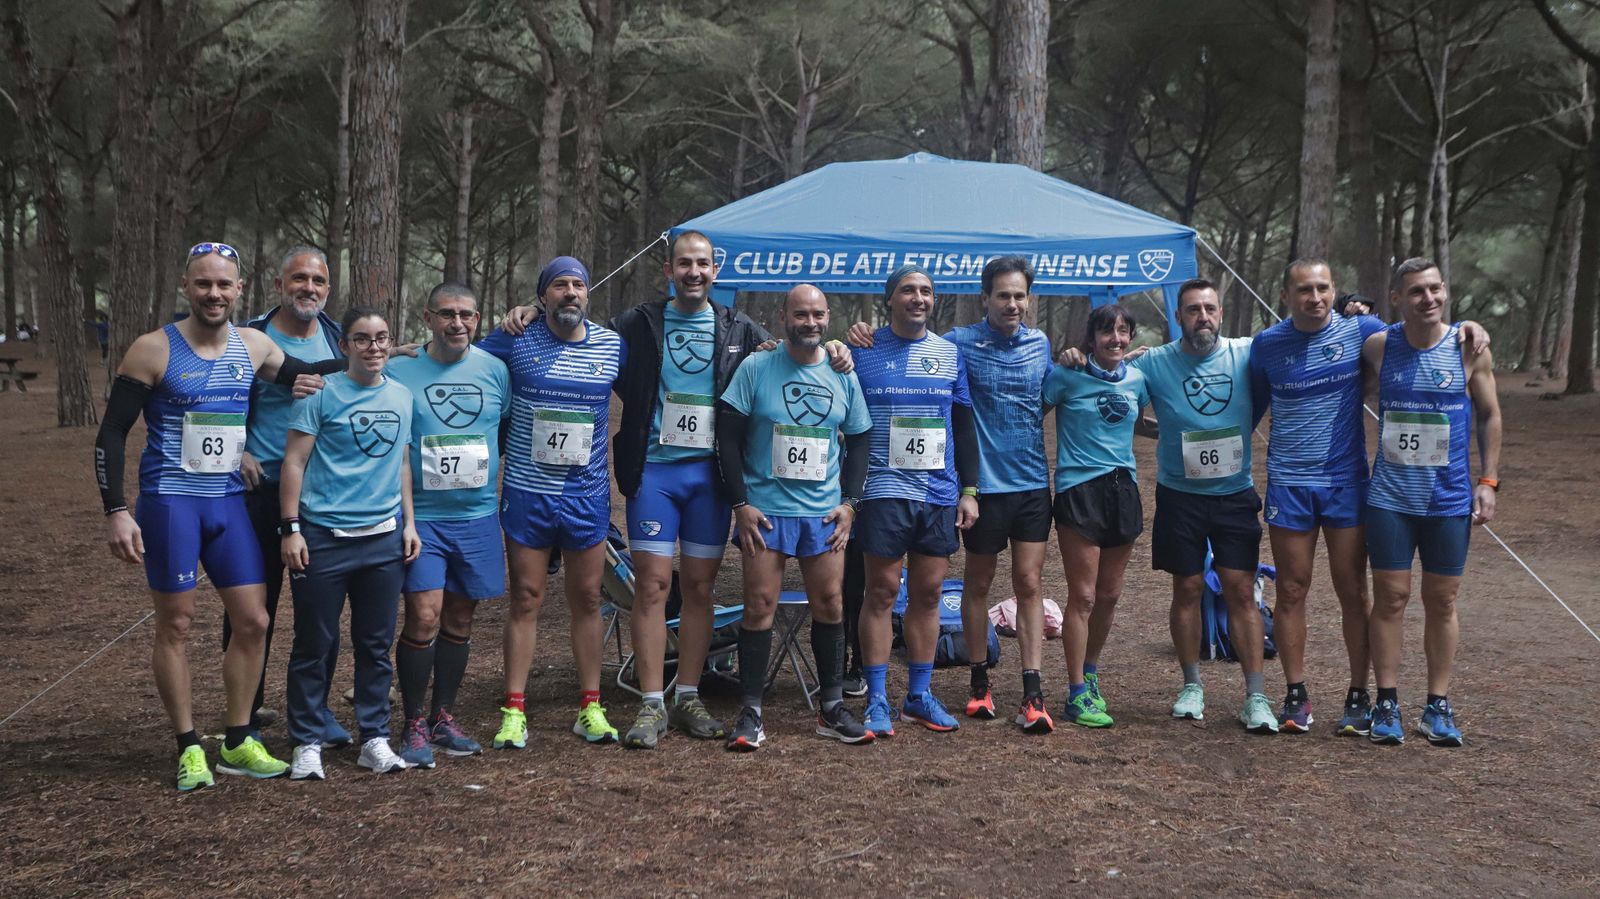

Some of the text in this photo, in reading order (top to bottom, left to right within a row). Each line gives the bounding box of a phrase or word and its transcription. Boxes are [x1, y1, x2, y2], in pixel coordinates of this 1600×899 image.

[733, 252, 803, 275] CLUB
[809, 252, 848, 275] DE
[1030, 253, 1130, 278] INENSE
[866, 387, 883, 395] Club
[885, 386, 927, 395] Atletismo
[1284, 377, 1330, 390] Atletismo
[539, 389, 581, 399] ATLETISMO
[1391, 400, 1434, 410] Atletismo
[676, 414, 698, 433] 46
[202, 436, 224, 456] 63
[547, 431, 569, 450] 47
[905, 437, 925, 455] 45
[1398, 433, 1420, 451] 55
[787, 446, 808, 465] 64
[1200, 449, 1219, 466] 66
[440, 456, 461, 475] 57
